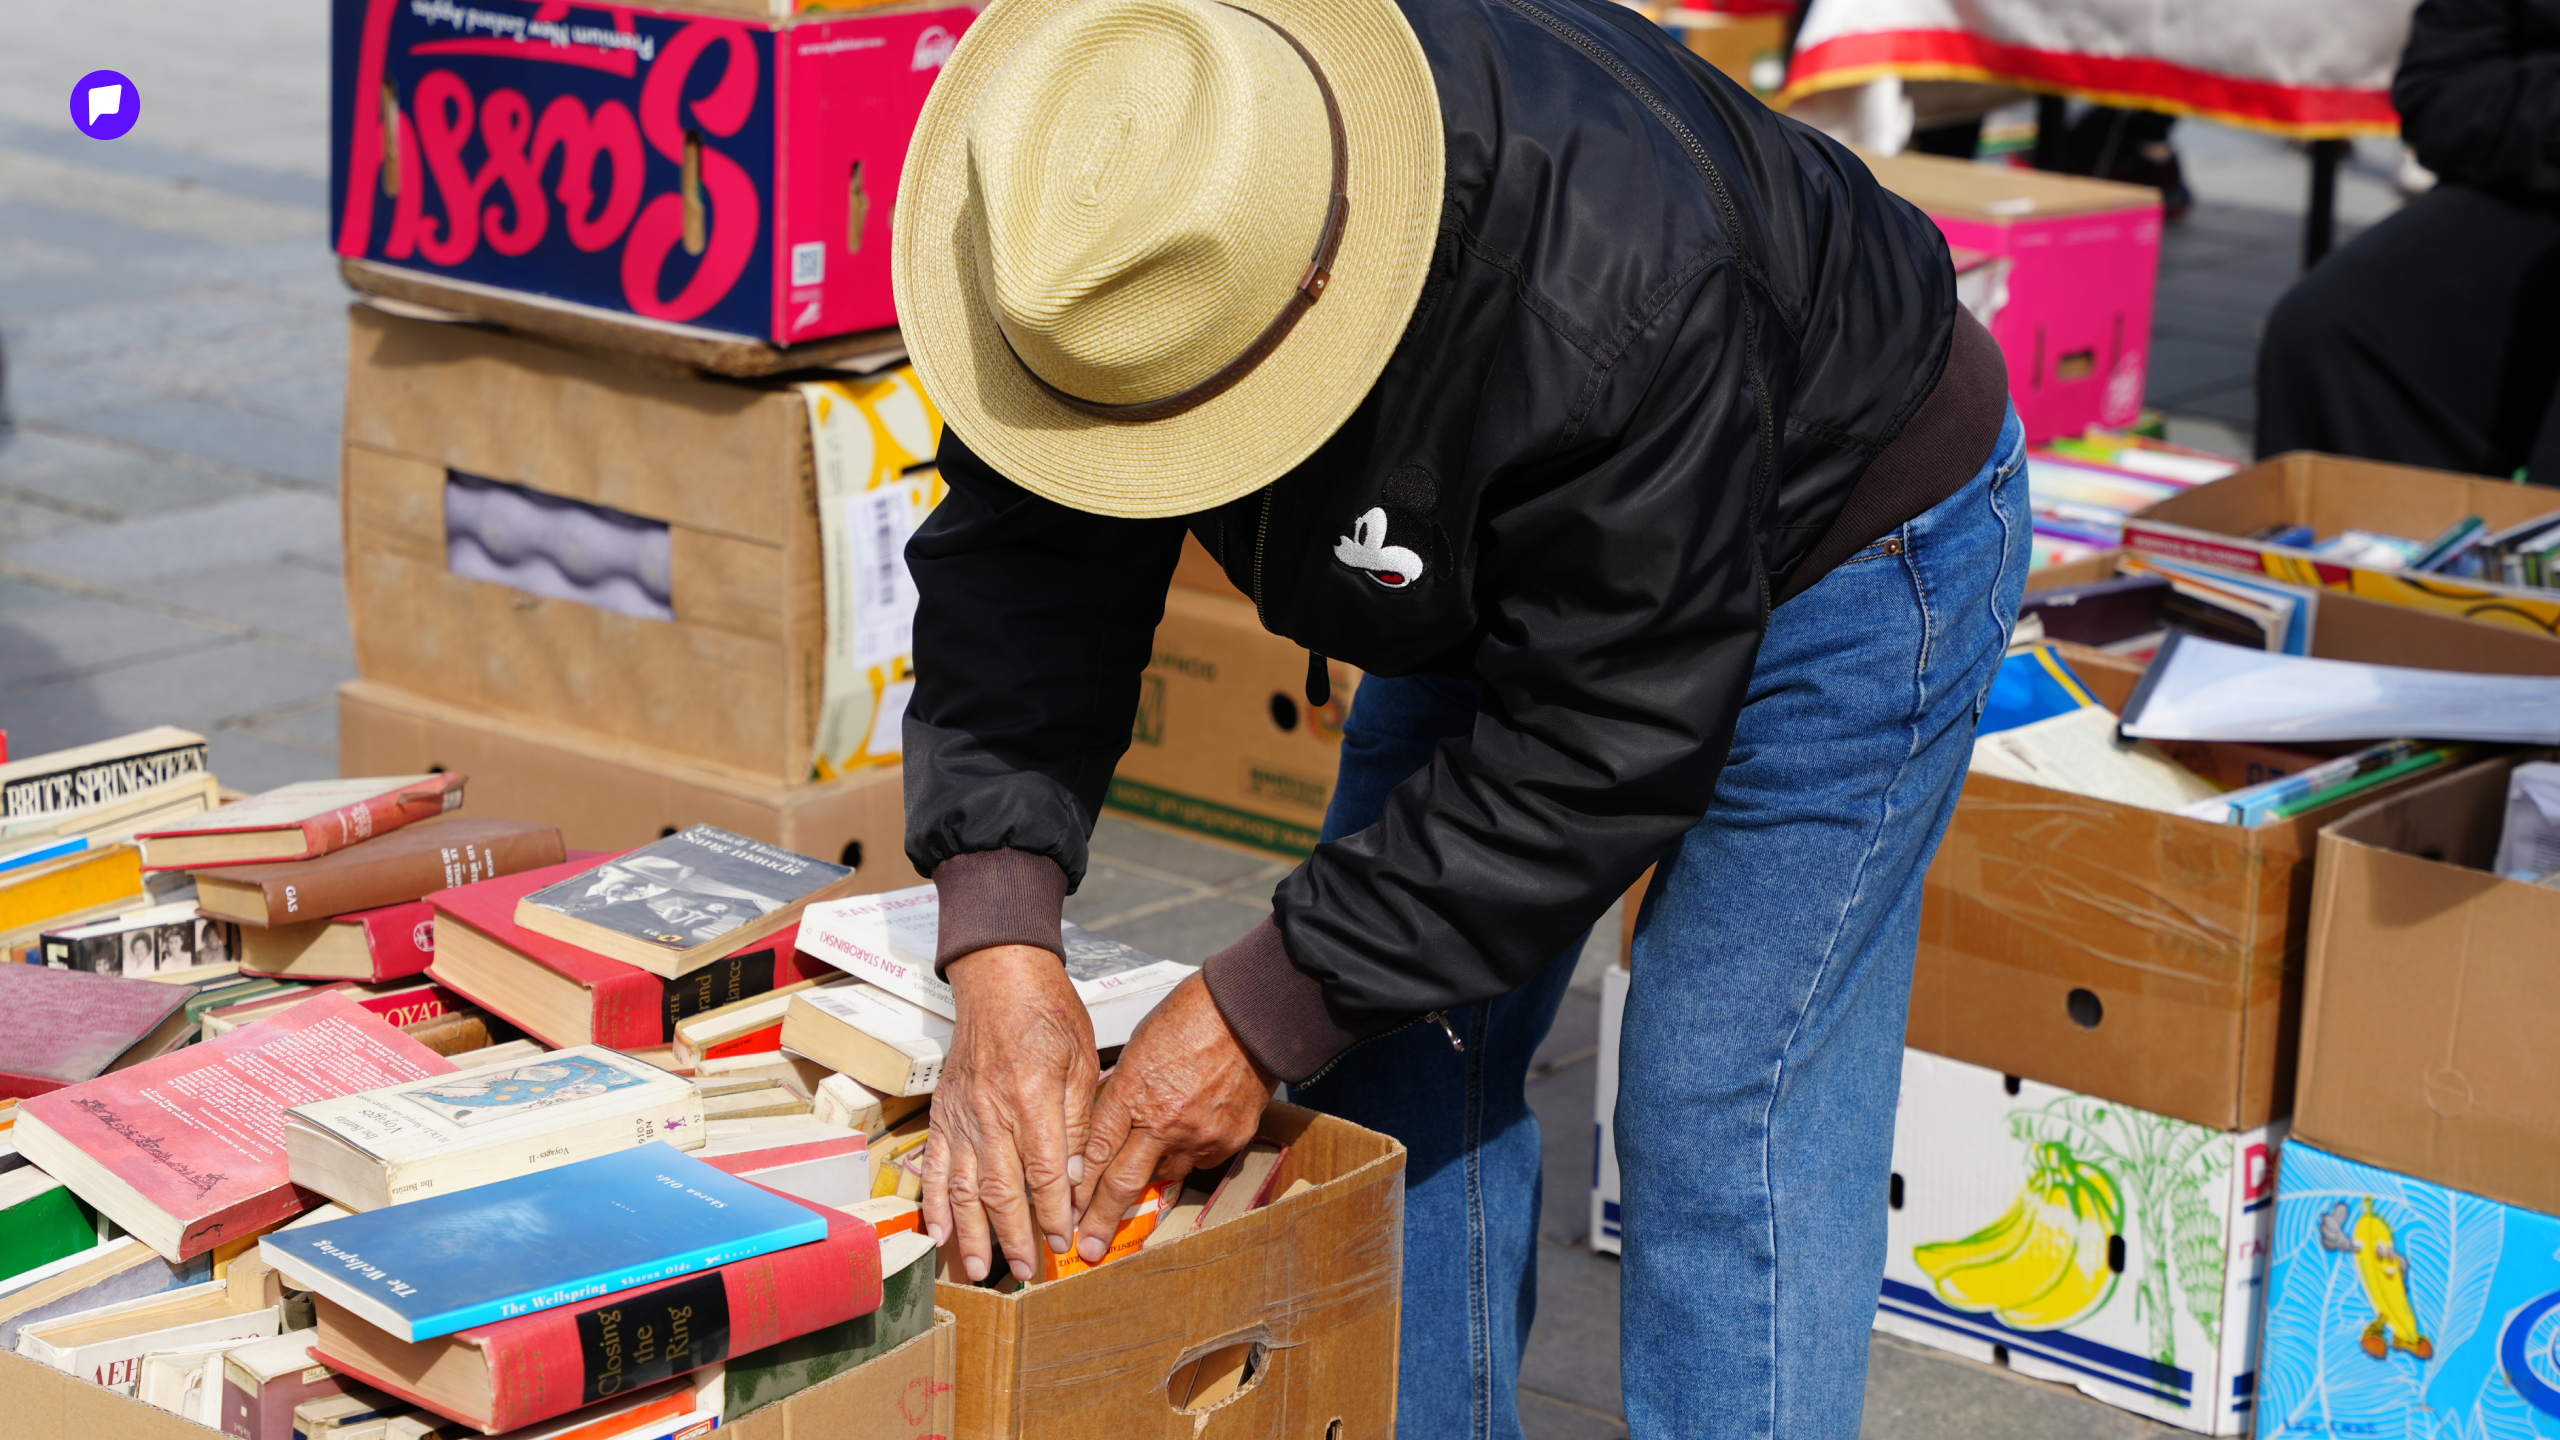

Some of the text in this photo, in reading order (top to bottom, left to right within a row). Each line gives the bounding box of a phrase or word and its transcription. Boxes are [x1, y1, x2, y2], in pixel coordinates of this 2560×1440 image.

[464, 8, 528, 43] Zealand
[526, 19, 571, 49] New
[337, 0, 760, 323] Sassy
[6, 745, 208, 816] BRUCE SPRINGSTEEN
[440, 848, 454, 889] DES MORT
[449, 848, 461, 888] LE TEMP
[466, 844, 481, 884] LES BÊTE
[481, 848, 498, 877] GASCAR
[679, 832, 803, 876] Sang maudit
[285, 885, 299, 914] GAS
[833, 904, 879, 918] JEAN
[819, 930, 880, 967] STAROBINSKI
[880, 958, 906, 979] JEAN
[672, 993, 680, 1023] THE
[696, 975, 712, 1010] rand
[358, 1105, 405, 1136] Voyages
[645, 1120, 654, 1138] IBN
[538, 1145, 570, 1161] Voyages
[419, 1179, 433, 1189] Ibn
[655, 1173, 728, 1210] Sharon Olds
[312, 1239, 419, 1299] The Wellspring
[500, 1300, 527, 1318] The
[531, 1282, 609, 1310] Wellspring
[621, 1269, 664, 1287] Sharon
[666, 1261, 692, 1280] Olds
[756, 1265, 777, 1338] Churchill
[746, 1282, 758, 1344] WINSTON
[597, 1309, 622, 1397] Closing
[635, 1325, 655, 1366] the
[665, 1305, 692, 1370] Ring
